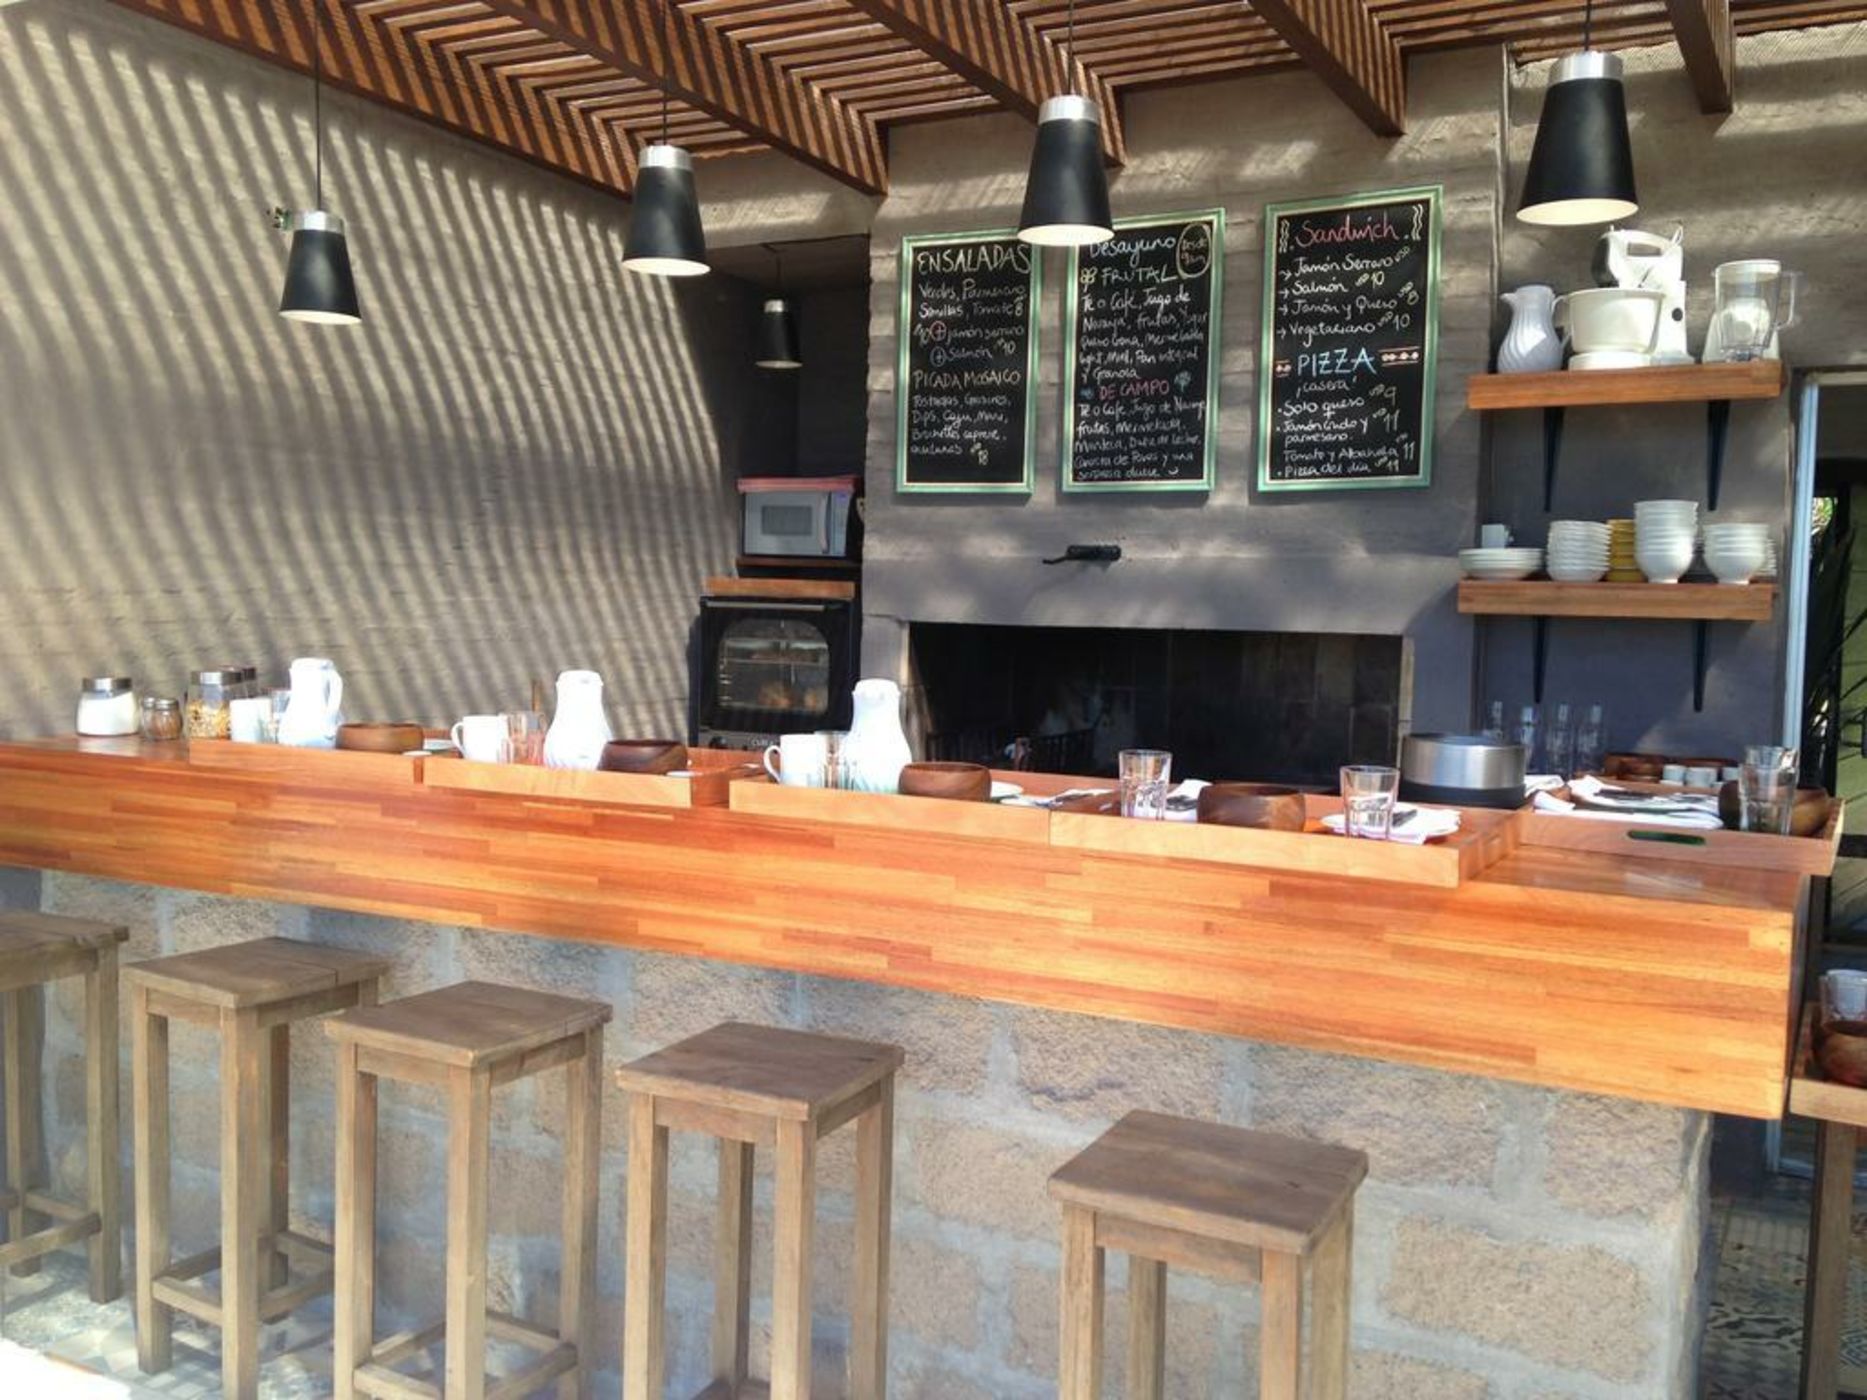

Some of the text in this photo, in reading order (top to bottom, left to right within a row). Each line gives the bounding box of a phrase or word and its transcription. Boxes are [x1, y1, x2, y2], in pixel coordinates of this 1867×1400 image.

[1295, 211, 1400, 248] Sandwich
[917, 244, 1031, 275] ENSALADAS
[1089, 237, 1177, 268] Desayuno
[1342, 252, 1394, 272] Serrano
[1101, 264, 1179, 287] FRUTAL
[1174, 284, 1191, 303] de
[1341, 303, 1352, 321] y
[1355, 294, 1398, 315] Queso
[1288, 320, 1376, 347] Vegetariano
[1392, 312, 1411, 331] 10
[1297, 346, 1378, 378] PIZZA
[1099, 378, 1171, 401] DE CAMPO
[1283, 399, 1319, 417] Solo
